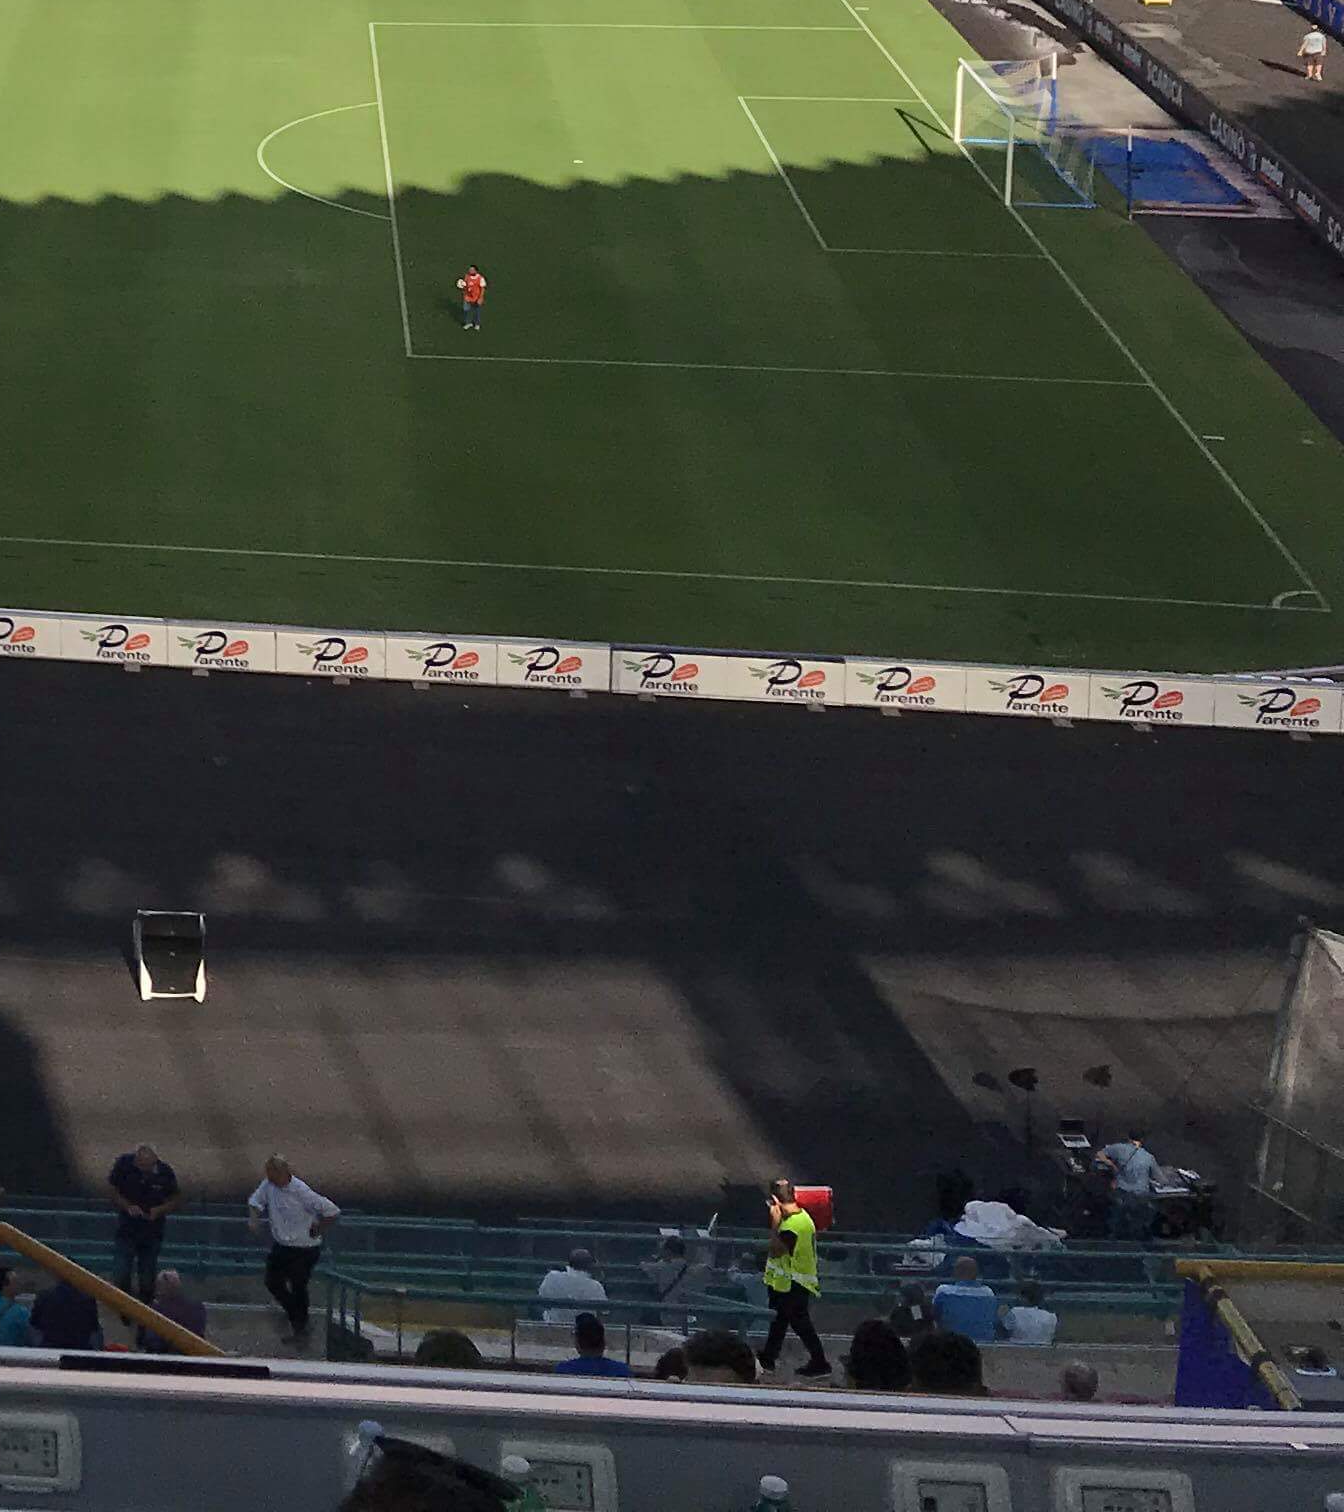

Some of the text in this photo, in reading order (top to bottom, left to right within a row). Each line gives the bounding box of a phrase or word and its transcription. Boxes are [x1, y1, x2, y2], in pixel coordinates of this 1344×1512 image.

[97, 624, 151, 662] Parente
[194, 631, 249, 668] Parente
[313, 637, 369, 675] Parente
[422, 643, 479, 681] Parente
[524, 646, 582, 685] Parente
[640, 653, 699, 691] Parente
[766, 661, 826, 699] Parente
[874, 667, 936, 705] Parente
[1006, 674, 1070, 713] Parente
[1120, 681, 1184, 721] Parente
[1256, 688, 1320, 728] Parente
